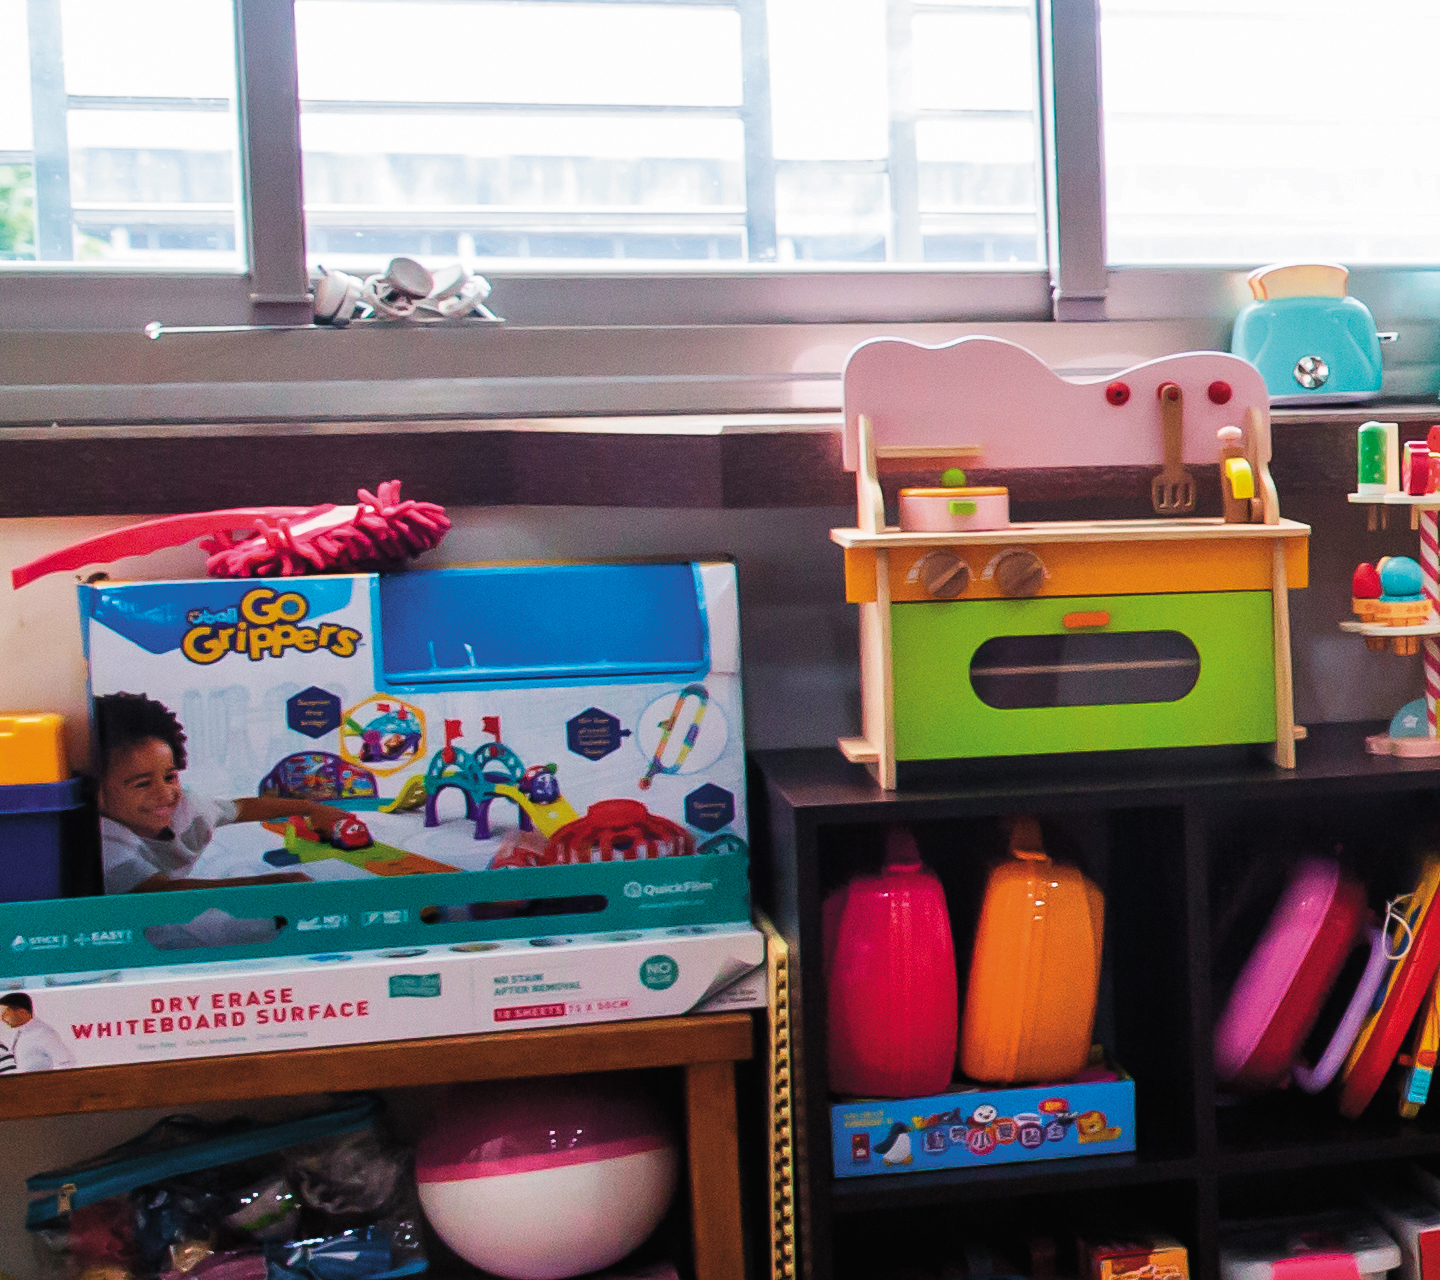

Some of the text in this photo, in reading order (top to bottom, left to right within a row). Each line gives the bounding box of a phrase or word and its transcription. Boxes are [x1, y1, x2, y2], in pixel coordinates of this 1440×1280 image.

[241, 588, 309, 624] GO
[181, 623, 362, 664] Grippers
[646, 962, 672, 974] NO
[151, 987, 293, 1015] DRY ERASE
[72, 1000, 370, 1040] WHITEBOARD SURFACE
